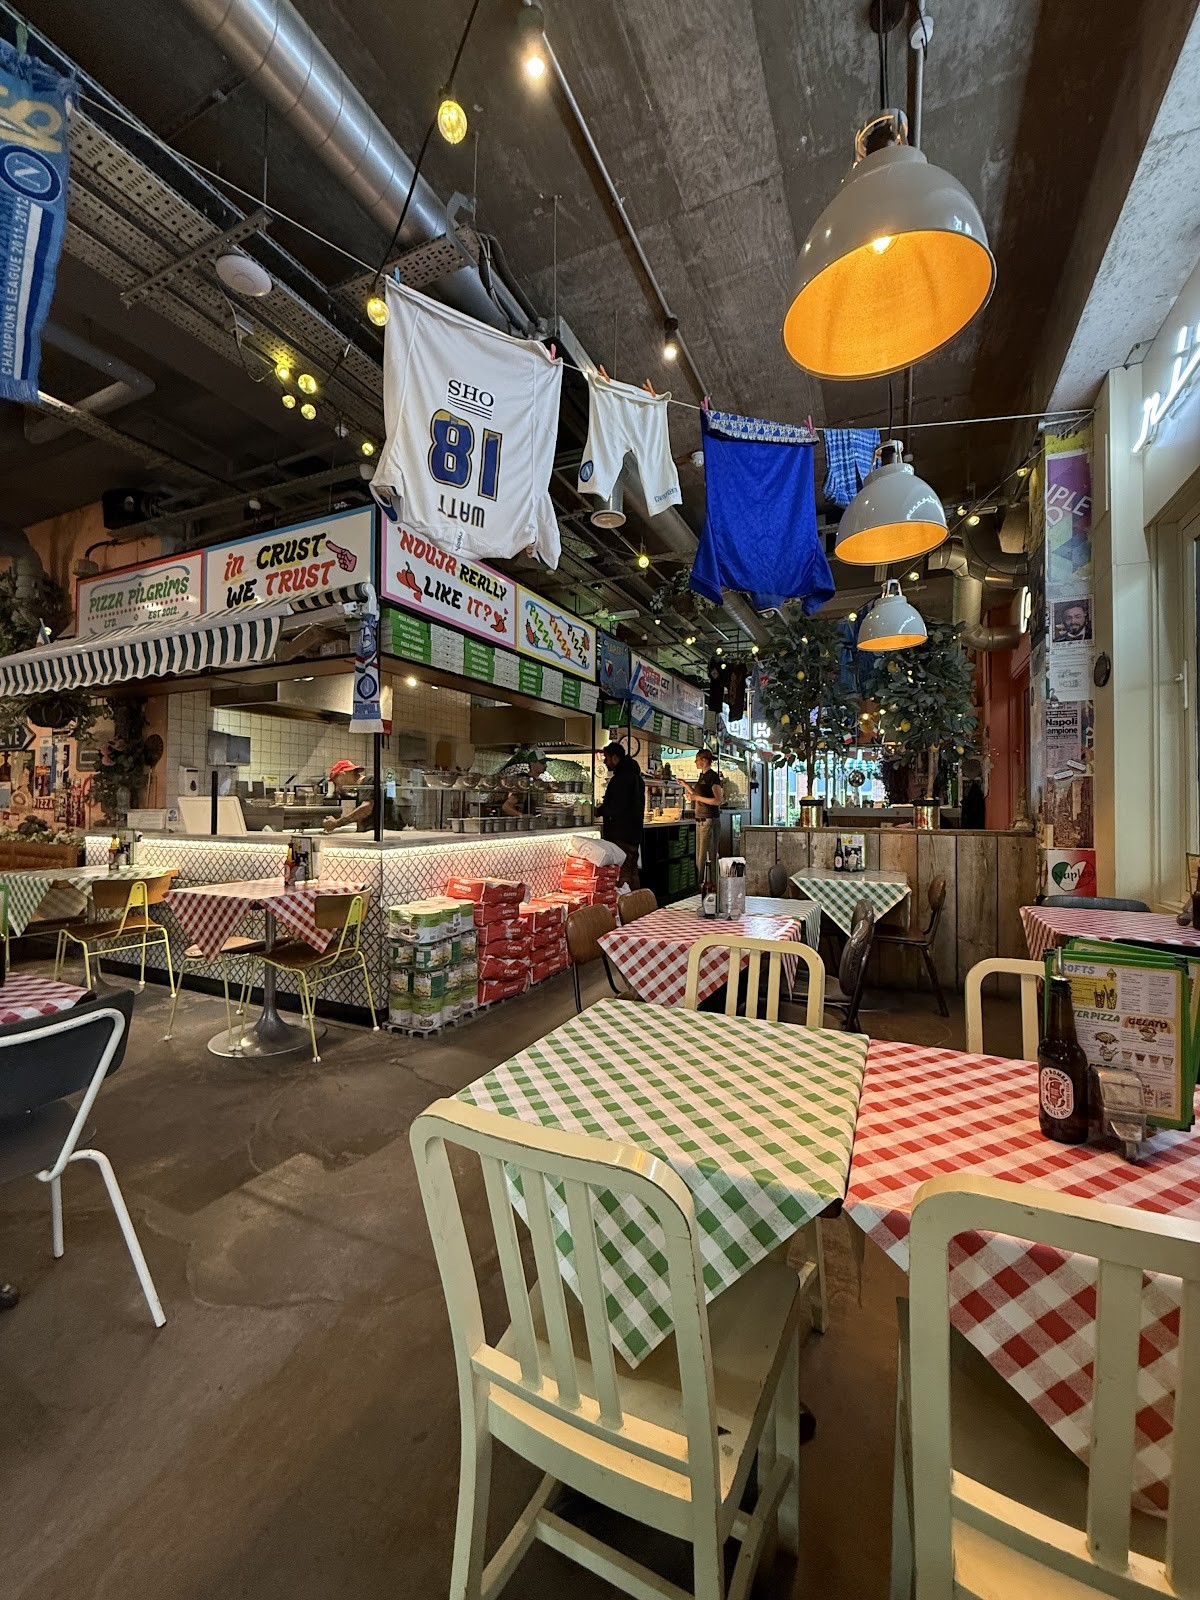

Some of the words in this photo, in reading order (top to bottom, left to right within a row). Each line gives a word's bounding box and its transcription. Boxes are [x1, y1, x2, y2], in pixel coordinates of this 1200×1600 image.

[8, 256, 23, 303] LEAGUE
[1, 304, 17, 376] CHAMPIONS
[437, 493, 486, 528] WATT
[256, 533, 327, 570] CRUST
[226, 578, 257, 609] WE
[265, 560, 336, 596] TRUST
[423, 575, 463, 609] LIKE
[467, 596, 493, 621] IT?
[459, 563, 507, 601] REALLY
[89, 591, 124, 613] PIZZA
[148, 609, 161, 620] EST
[529, 604, 554, 651] PIZZA
[549, 613, 571, 660] PIZZA
[567, 623, 587, 668] PIZZA
[1046, 717, 1078, 727] Napoli
[1090, 1010, 1121, 1023] PIZZA
[1127, 1016, 1168, 1029] GELATO
